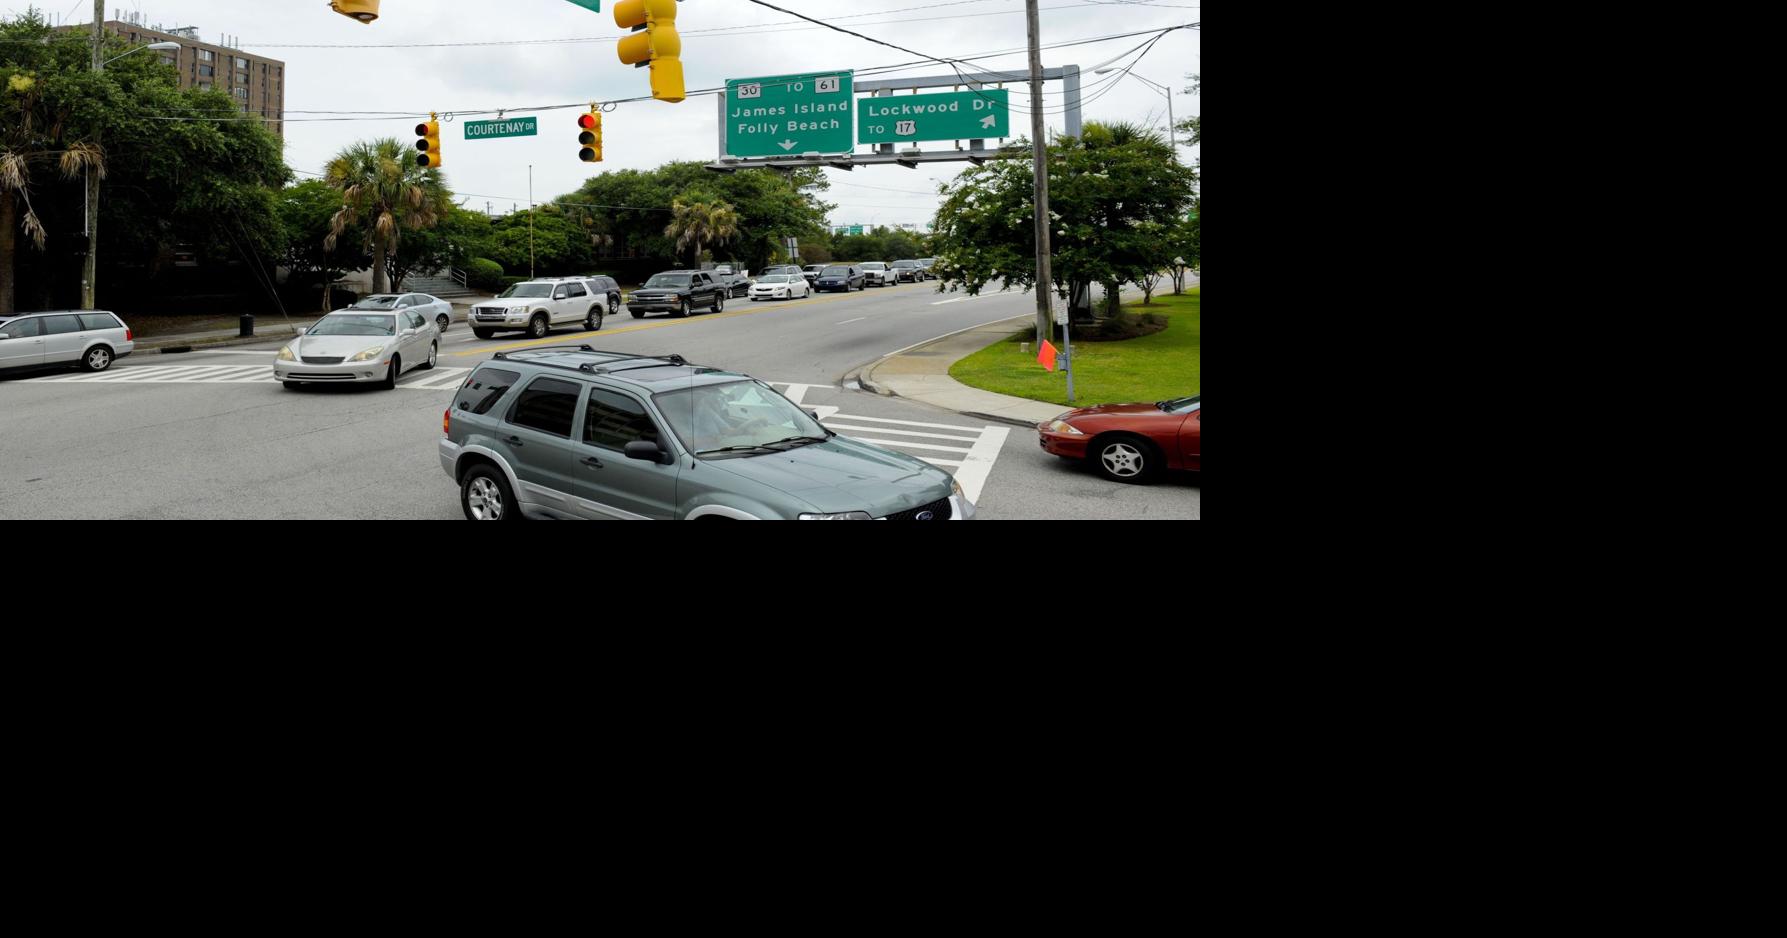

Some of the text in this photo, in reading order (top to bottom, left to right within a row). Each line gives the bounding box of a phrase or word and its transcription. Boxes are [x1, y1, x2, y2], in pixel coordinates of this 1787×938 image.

[742, 79, 835, 96] 30 TO 61
[732, 100, 848, 118] James Island
[869, 99, 995, 117] Lockwood Dr
[467, 122, 535, 136] COURTENAY DR
[738, 119, 839, 135] Folly Beach
[868, 122, 911, 134] TO 17
